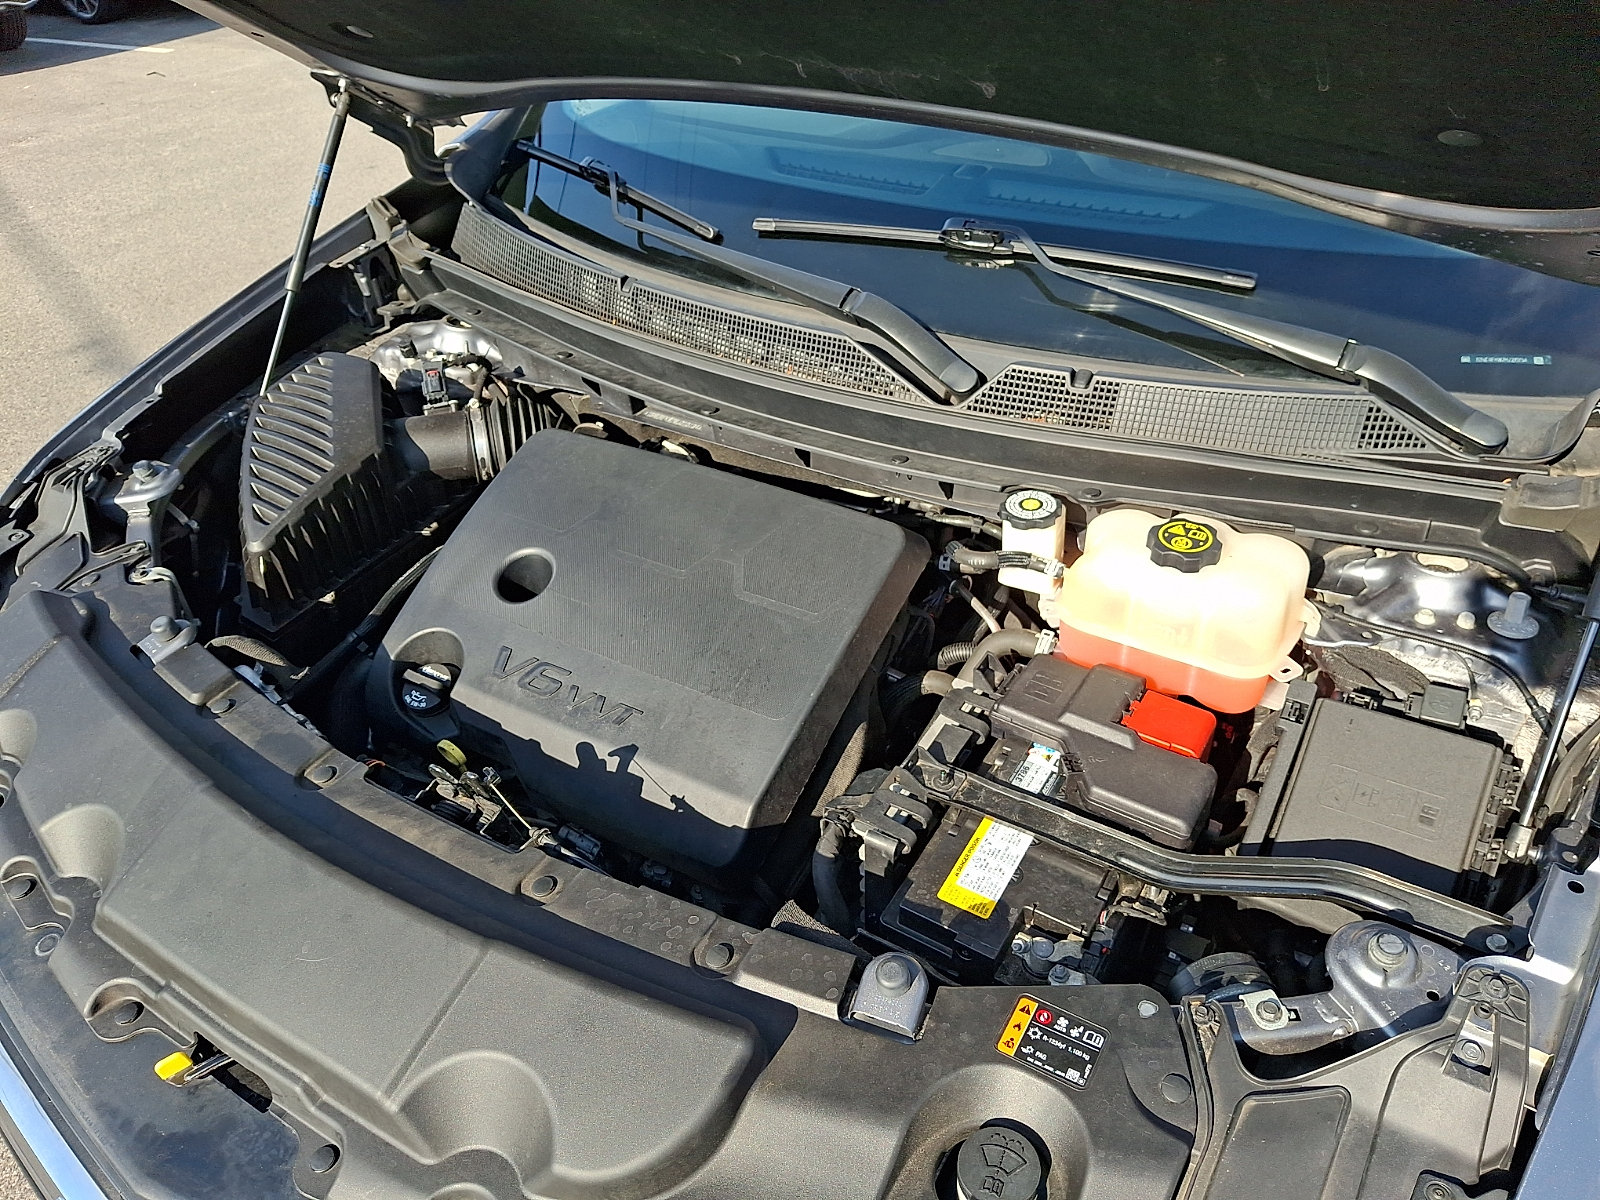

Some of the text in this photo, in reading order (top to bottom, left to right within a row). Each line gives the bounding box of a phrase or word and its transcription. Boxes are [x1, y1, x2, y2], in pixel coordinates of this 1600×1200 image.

[492, 645, 645, 726] V6 VVT
[1016, 766, 1030, 782] 3786
